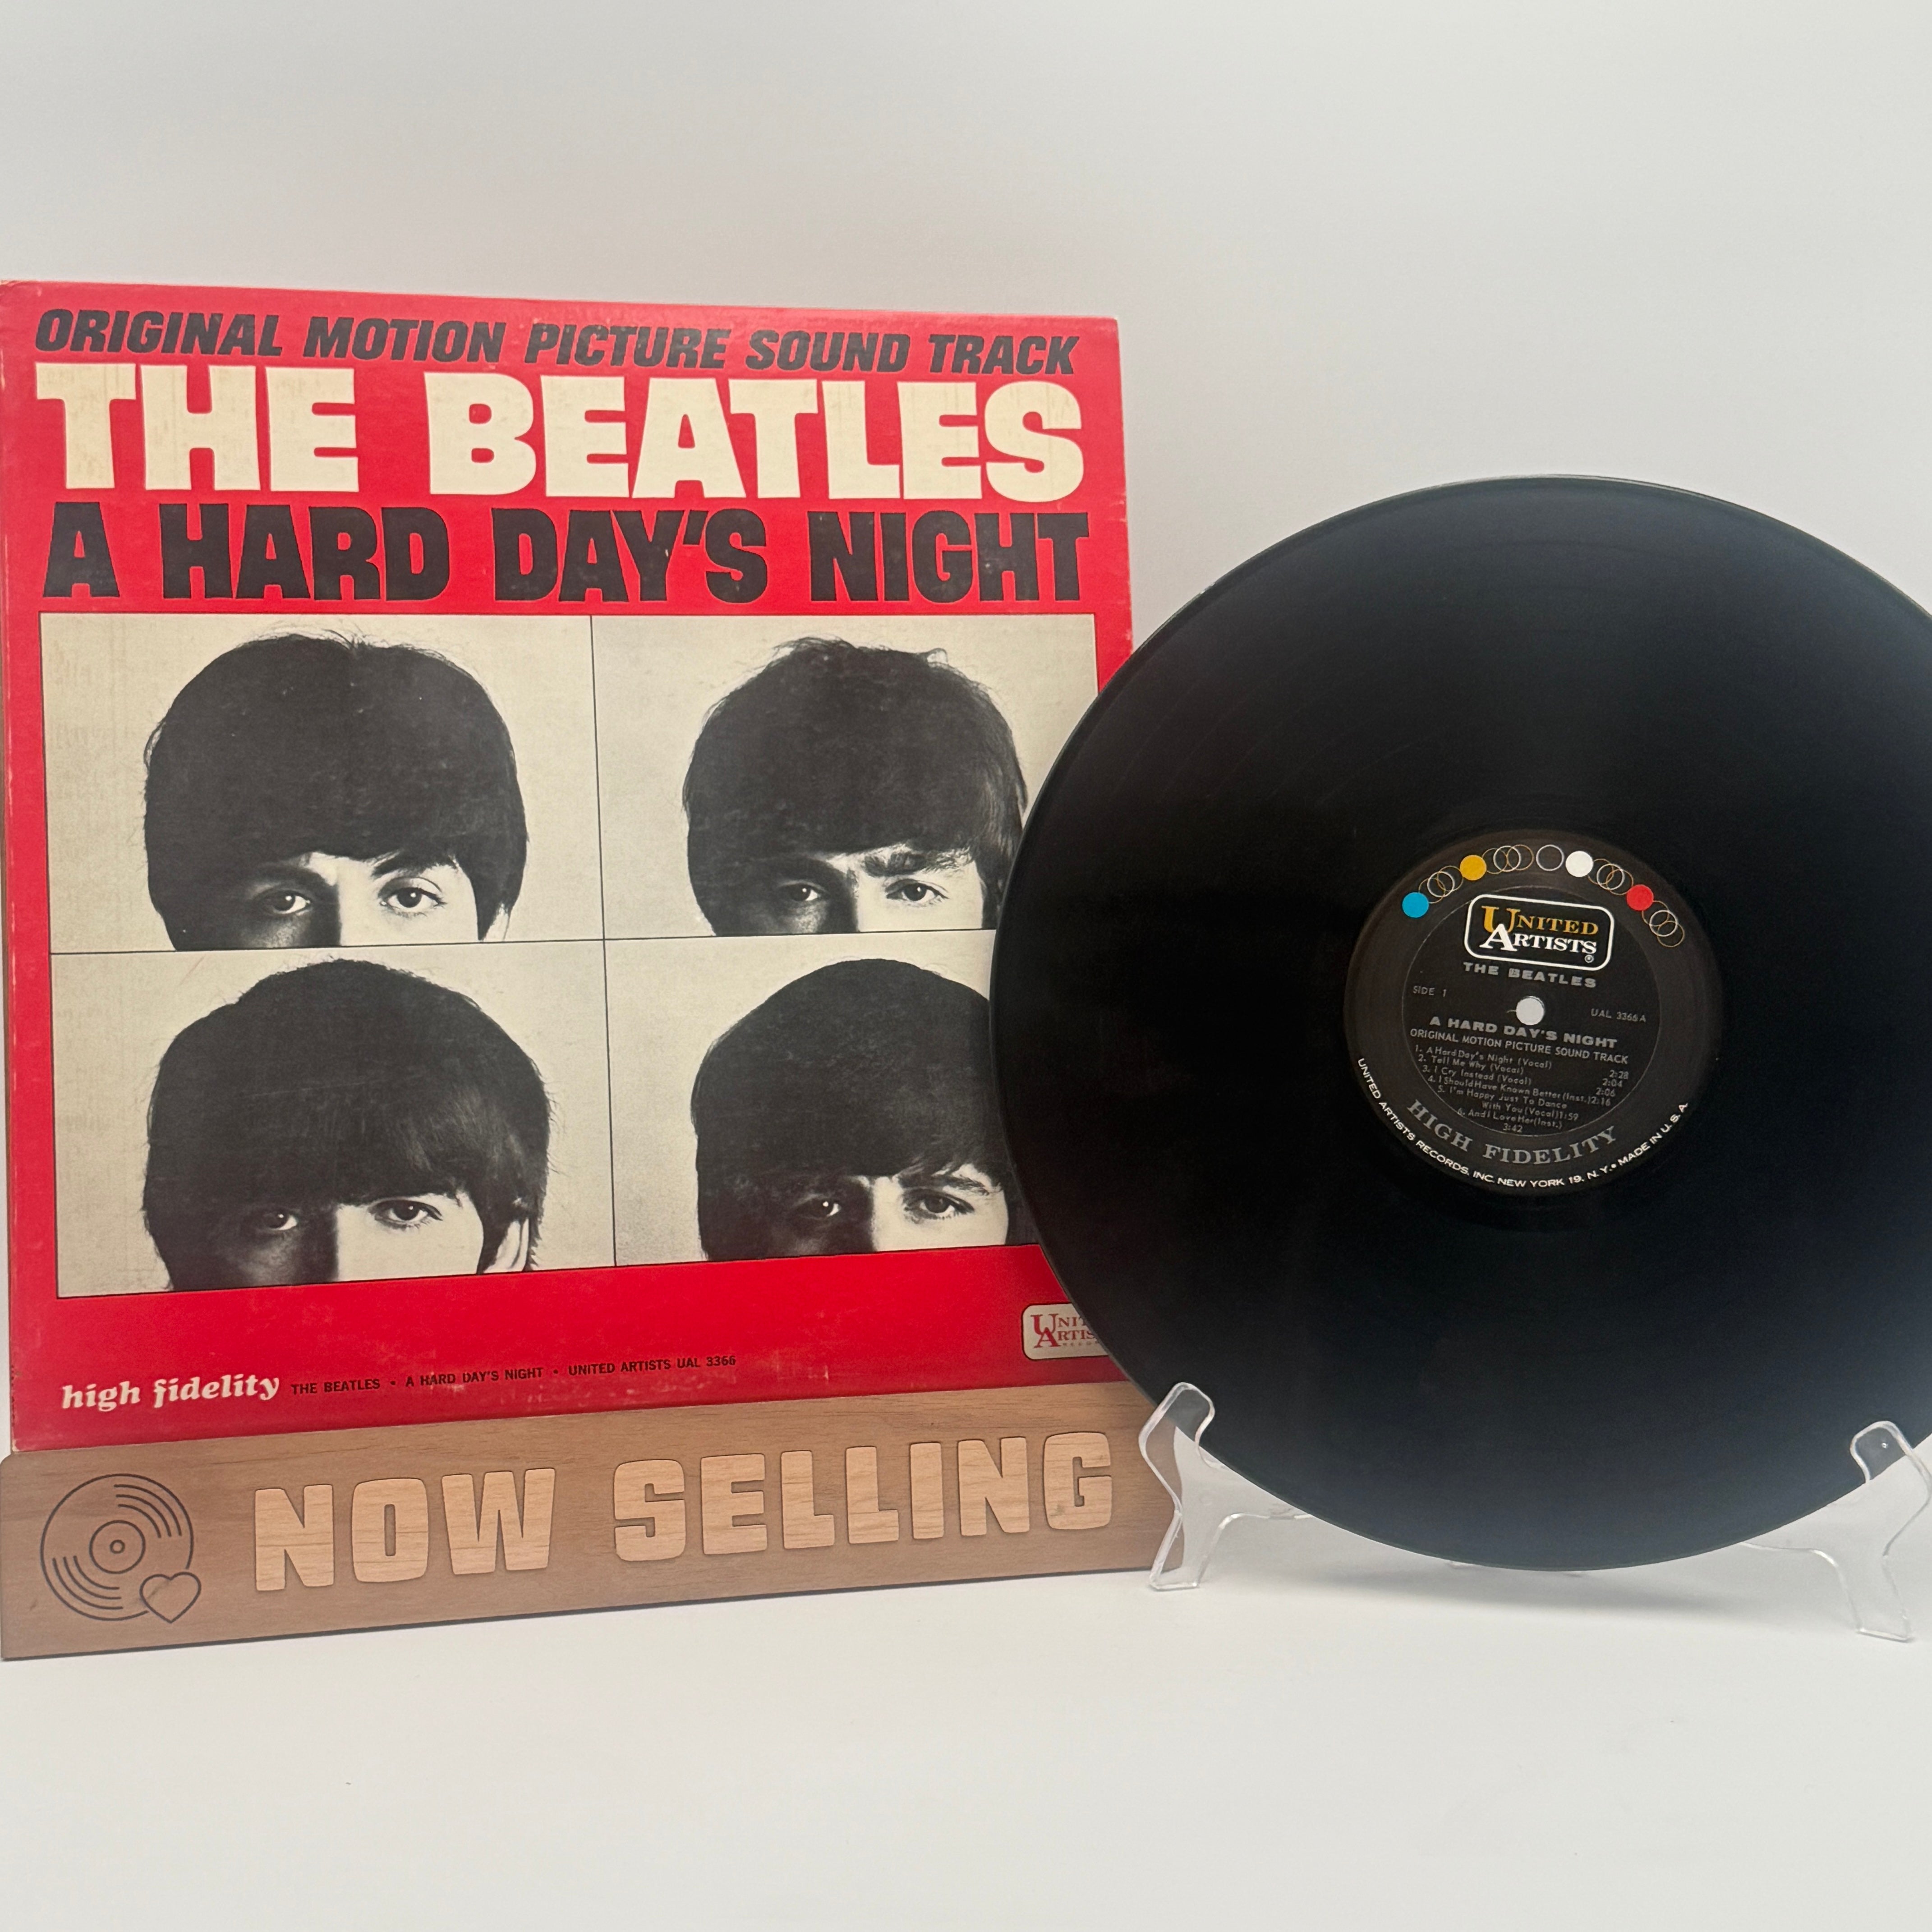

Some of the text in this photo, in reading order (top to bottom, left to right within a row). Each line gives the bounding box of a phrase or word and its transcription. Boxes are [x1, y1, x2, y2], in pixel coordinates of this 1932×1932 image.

[35, 308, 1080, 376] ORIGINAL MOTION PICTURE SOUND TRACK
[36, 362, 1085, 502] THE BEATLES
[42, 501, 1089, 603] A HARD DAY'S NIGHT
[1481, 906, 1599, 935] UNITED
[1479, 923, 1597, 954] ARTISTS
[1463, 961, 1596, 988] THE BEATLES
[1413, 986, 1446, 997] SIDE 1
[1591, 1008, 1612, 1018] UAL
[1410, 1029, 1628, 1064] ORIGINAL MOTION PICTURE SOUND TRACK
[1429, 1017, 1617, 1048] A HARD DAY'S NIGHT
[1431, 1055, 1449, 1064] Tell
[1469, 1061, 1486, 1071] Why
[1490, 1064, 1524, 1075] (Vocal)
[1602, 1078, 1623, 1087] 2:04
[1488, 1054, 1513, 1064] Night
[1518, 1058, 1552, 1069] (Vocal)
[1422, 1065, 1430, 1073] 3.
[1441, 1067, 1457, 1077] Cry
[1461, 1069, 1494, 1081] Instead
[1497, 1075, 1532, 1085] (Vocal)
[1596, 1087, 1615, 1097] 2:06
[1500, 1084, 1530, 1095] Known
[1532, 1088, 1560, 1099] Better
[1449, 1086, 1464, 1095] I'm
[1467, 1089, 1495, 1100] Happy
[1523, 1096, 1534, 1104] To
[1538, 1098, 1567, 1109] Dance
[1482, 1101, 1501, 1110] With
[1358, 1058, 1381, 1099] UNITED
[1379, 1102, 1416, 1141] ARTISTS
[1497, 1178, 1527, 1187] NEW
[1530, 1178, 1564, 1187] YORK
[1617, 1142, 1651, 1165] MADE
[1649, 1132, 1663, 1144] IN
[1407, 1099, 1616, 1164] HIGH FIDELITY
[1503, 1122, 1523, 1133] 3:42
[62, 1355, 736, 1412] high fidelity THE BEATLES A HARD DAY'S NIGHT UNITED ARTISTS UAL 3366
[254, 1431, 1113, 1591] NOW SELLING
